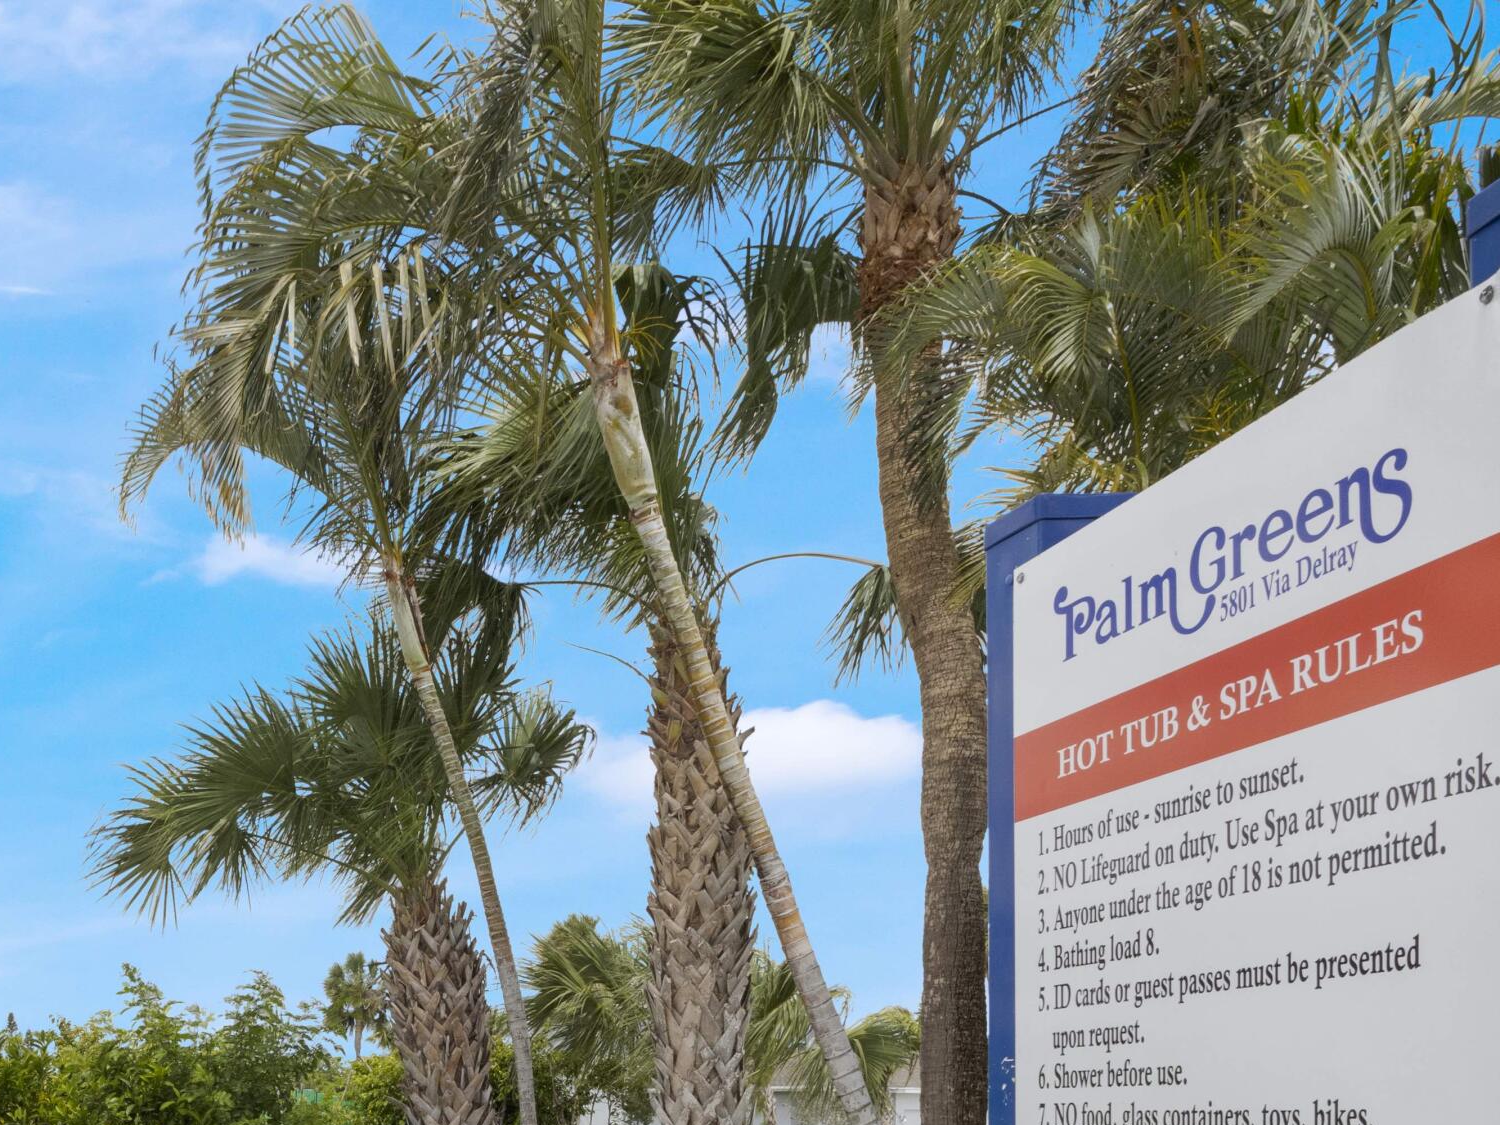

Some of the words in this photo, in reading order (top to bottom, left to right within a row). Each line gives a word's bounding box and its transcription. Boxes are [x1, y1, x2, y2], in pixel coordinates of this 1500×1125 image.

[1053, 564, 1216, 663] Palm
[1189, 447, 1414, 595] Greens
[1219, 584, 1257, 623] 5801
[1262, 564, 1291, 602] Via
[1296, 539, 1359, 586] Delray
[1056, 728, 1115, 781] HOT
[1119, 704, 1181, 757] TUB
[1186, 694, 1212, 733] &
[1219, 667, 1283, 722] SPA
[1289, 608, 1425, 697] RULES
[1037, 868, 1050, 897] 2.
[1052, 860, 1078, 893] NO
[1080, 840, 1151, 887] Lifeguard
[1154, 843, 1175, 869] on
[1179, 829, 1220, 864] duty.
[1224, 816, 1260, 851] Use
[1264, 807, 1300, 849] Spa
[1304, 799, 1325, 833] at
[1329, 790, 1380, 836] your
[1385, 775, 1438, 813] own
[1443, 750, 1500, 799] risk.
[1038, 830, 1050, 857] 1.
[1052, 822, 1094, 853] Hours
[1097, 807, 1114, 841] of
[1115, 809, 1140, 836] use
[1154, 783, 1212, 825] sunrise
[1215, 779, 1234, 807] to
[1239, 756, 1305, 801] sunset.
[1037, 907, 1050, 936] 3.
[1053, 902, 1106, 935] Anyone
[1108, 886, 1152, 922] under
[1155, 880, 1181, 912] the
[1184, 879, 1213, 913] age
[1217, 863, 1238, 900] of
[1242, 859, 1262, 895] 18
[1267, 856, 1283, 890] is
[1288, 850, 1323, 886] not
[1327, 819, 1447, 888] permitted.
[1037, 946, 1050, 974] 4.
[1053, 938, 1107, 973] Bathing
[1109, 928, 1142, 963] load
[1145, 926, 1160, 958] 8.
[1038, 985, 1050, 1013] 5.
[1053, 981, 1072, 1011] ID
[1075, 976, 1111, 1009] cards
[1114, 982, 1131, 1005] or
[1133, 972, 1175, 1010] guest
[1177, 968, 1231, 1005] passes
[1235, 956, 1282, 991] must
[1285, 950, 1310, 985] be
[1314, 932, 1422, 991] presented
[1038, 1063, 1050, 1091] 6.
[1053, 1061, 1104, 1091] Shower
[1105, 1057, 1153, 1089] before
[1156, 1063, 1188, 1087] use.
[1051, 1028, 1086, 1058] upon
[1088, 1019, 1145, 1055] request.
